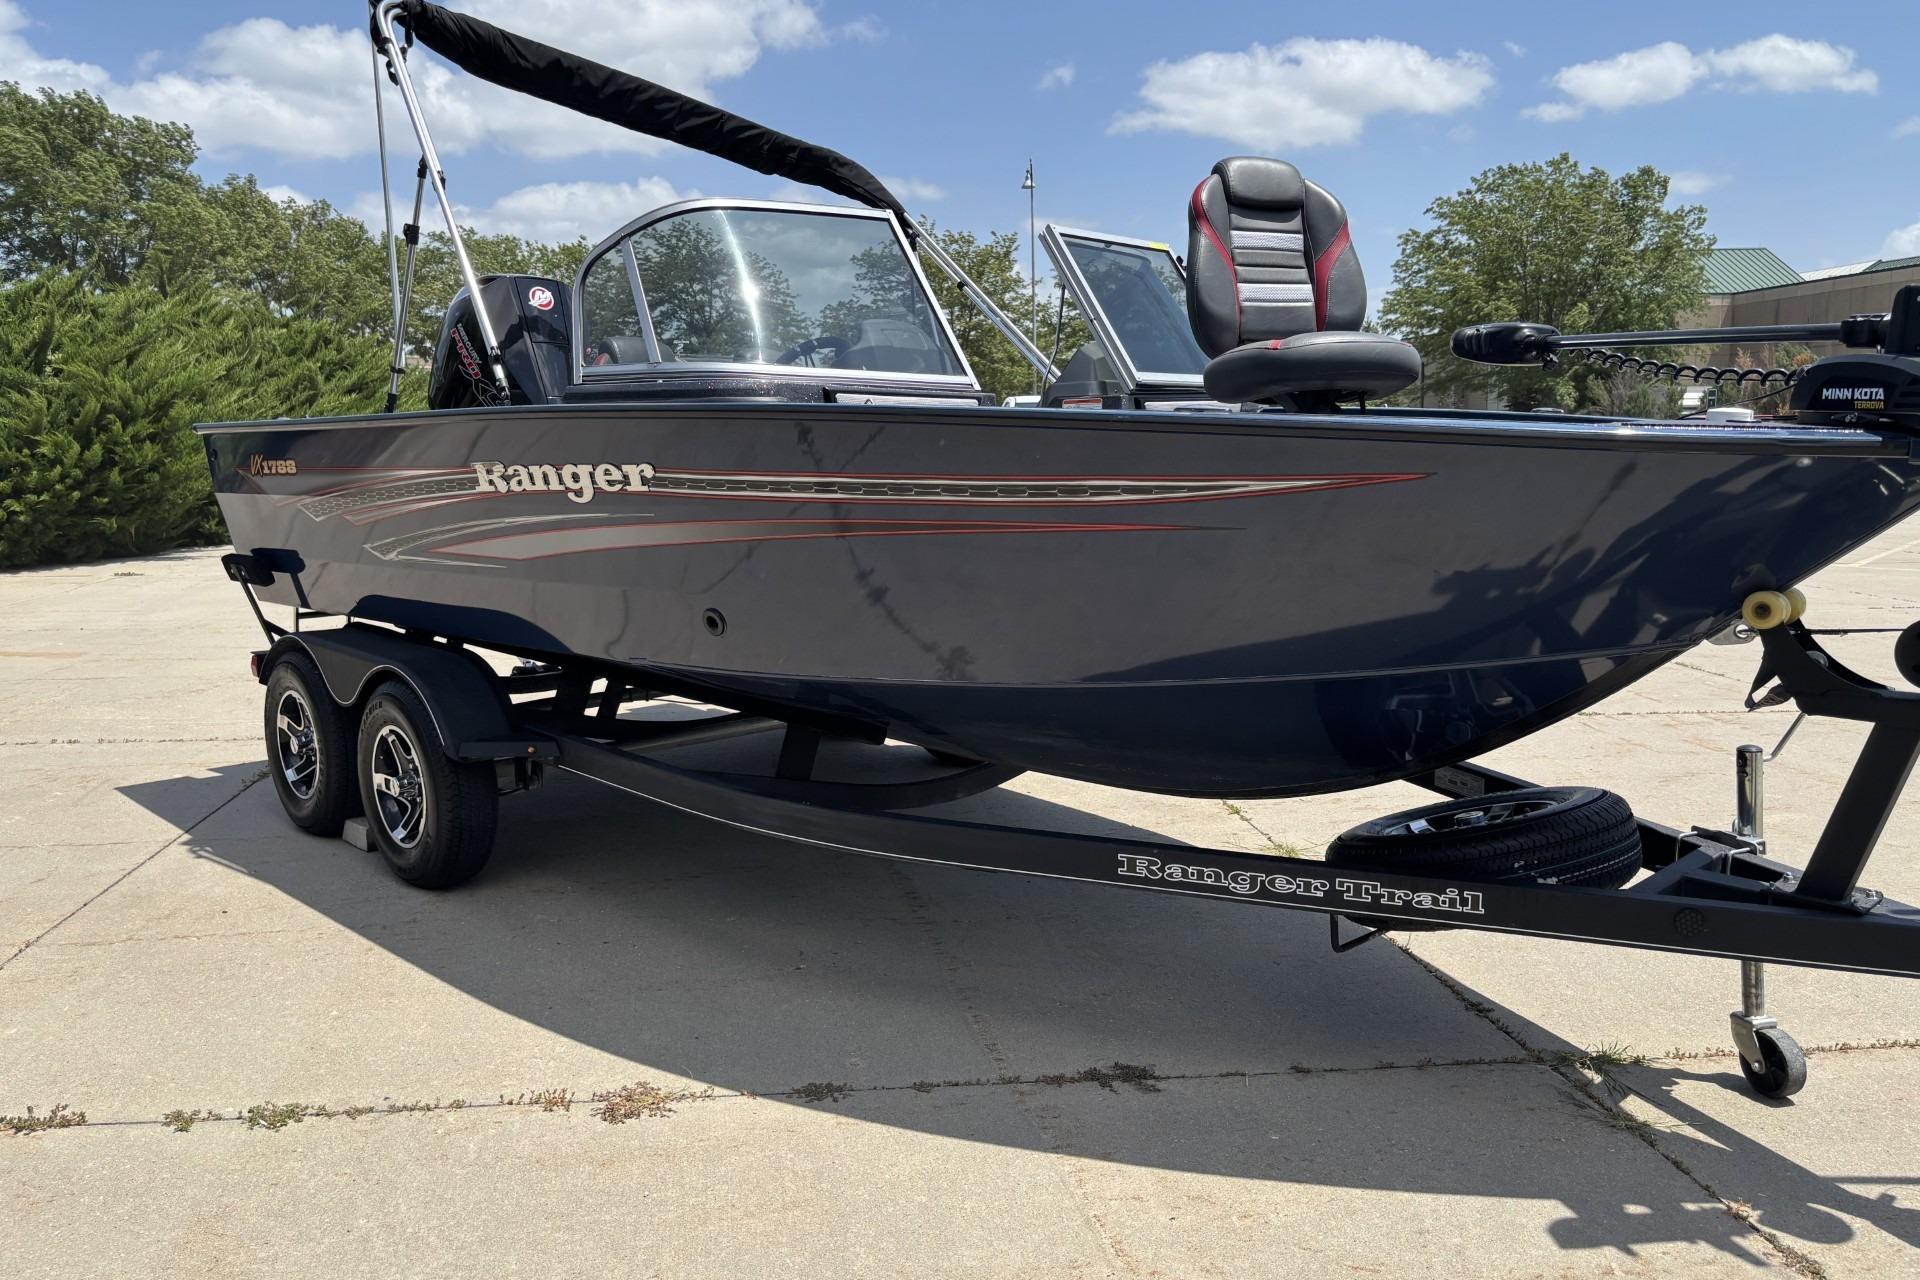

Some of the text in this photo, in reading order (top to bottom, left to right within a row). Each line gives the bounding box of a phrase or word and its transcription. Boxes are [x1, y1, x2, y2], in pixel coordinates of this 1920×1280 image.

[457, 324, 482, 364] MERCURY
[1822, 388, 1884, 400] MINN KOTA
[1854, 401, 1884, 409] TERROVA
[471, 461, 655, 503] Ranger
[1117, 854, 1485, 914] Ranger Trail
